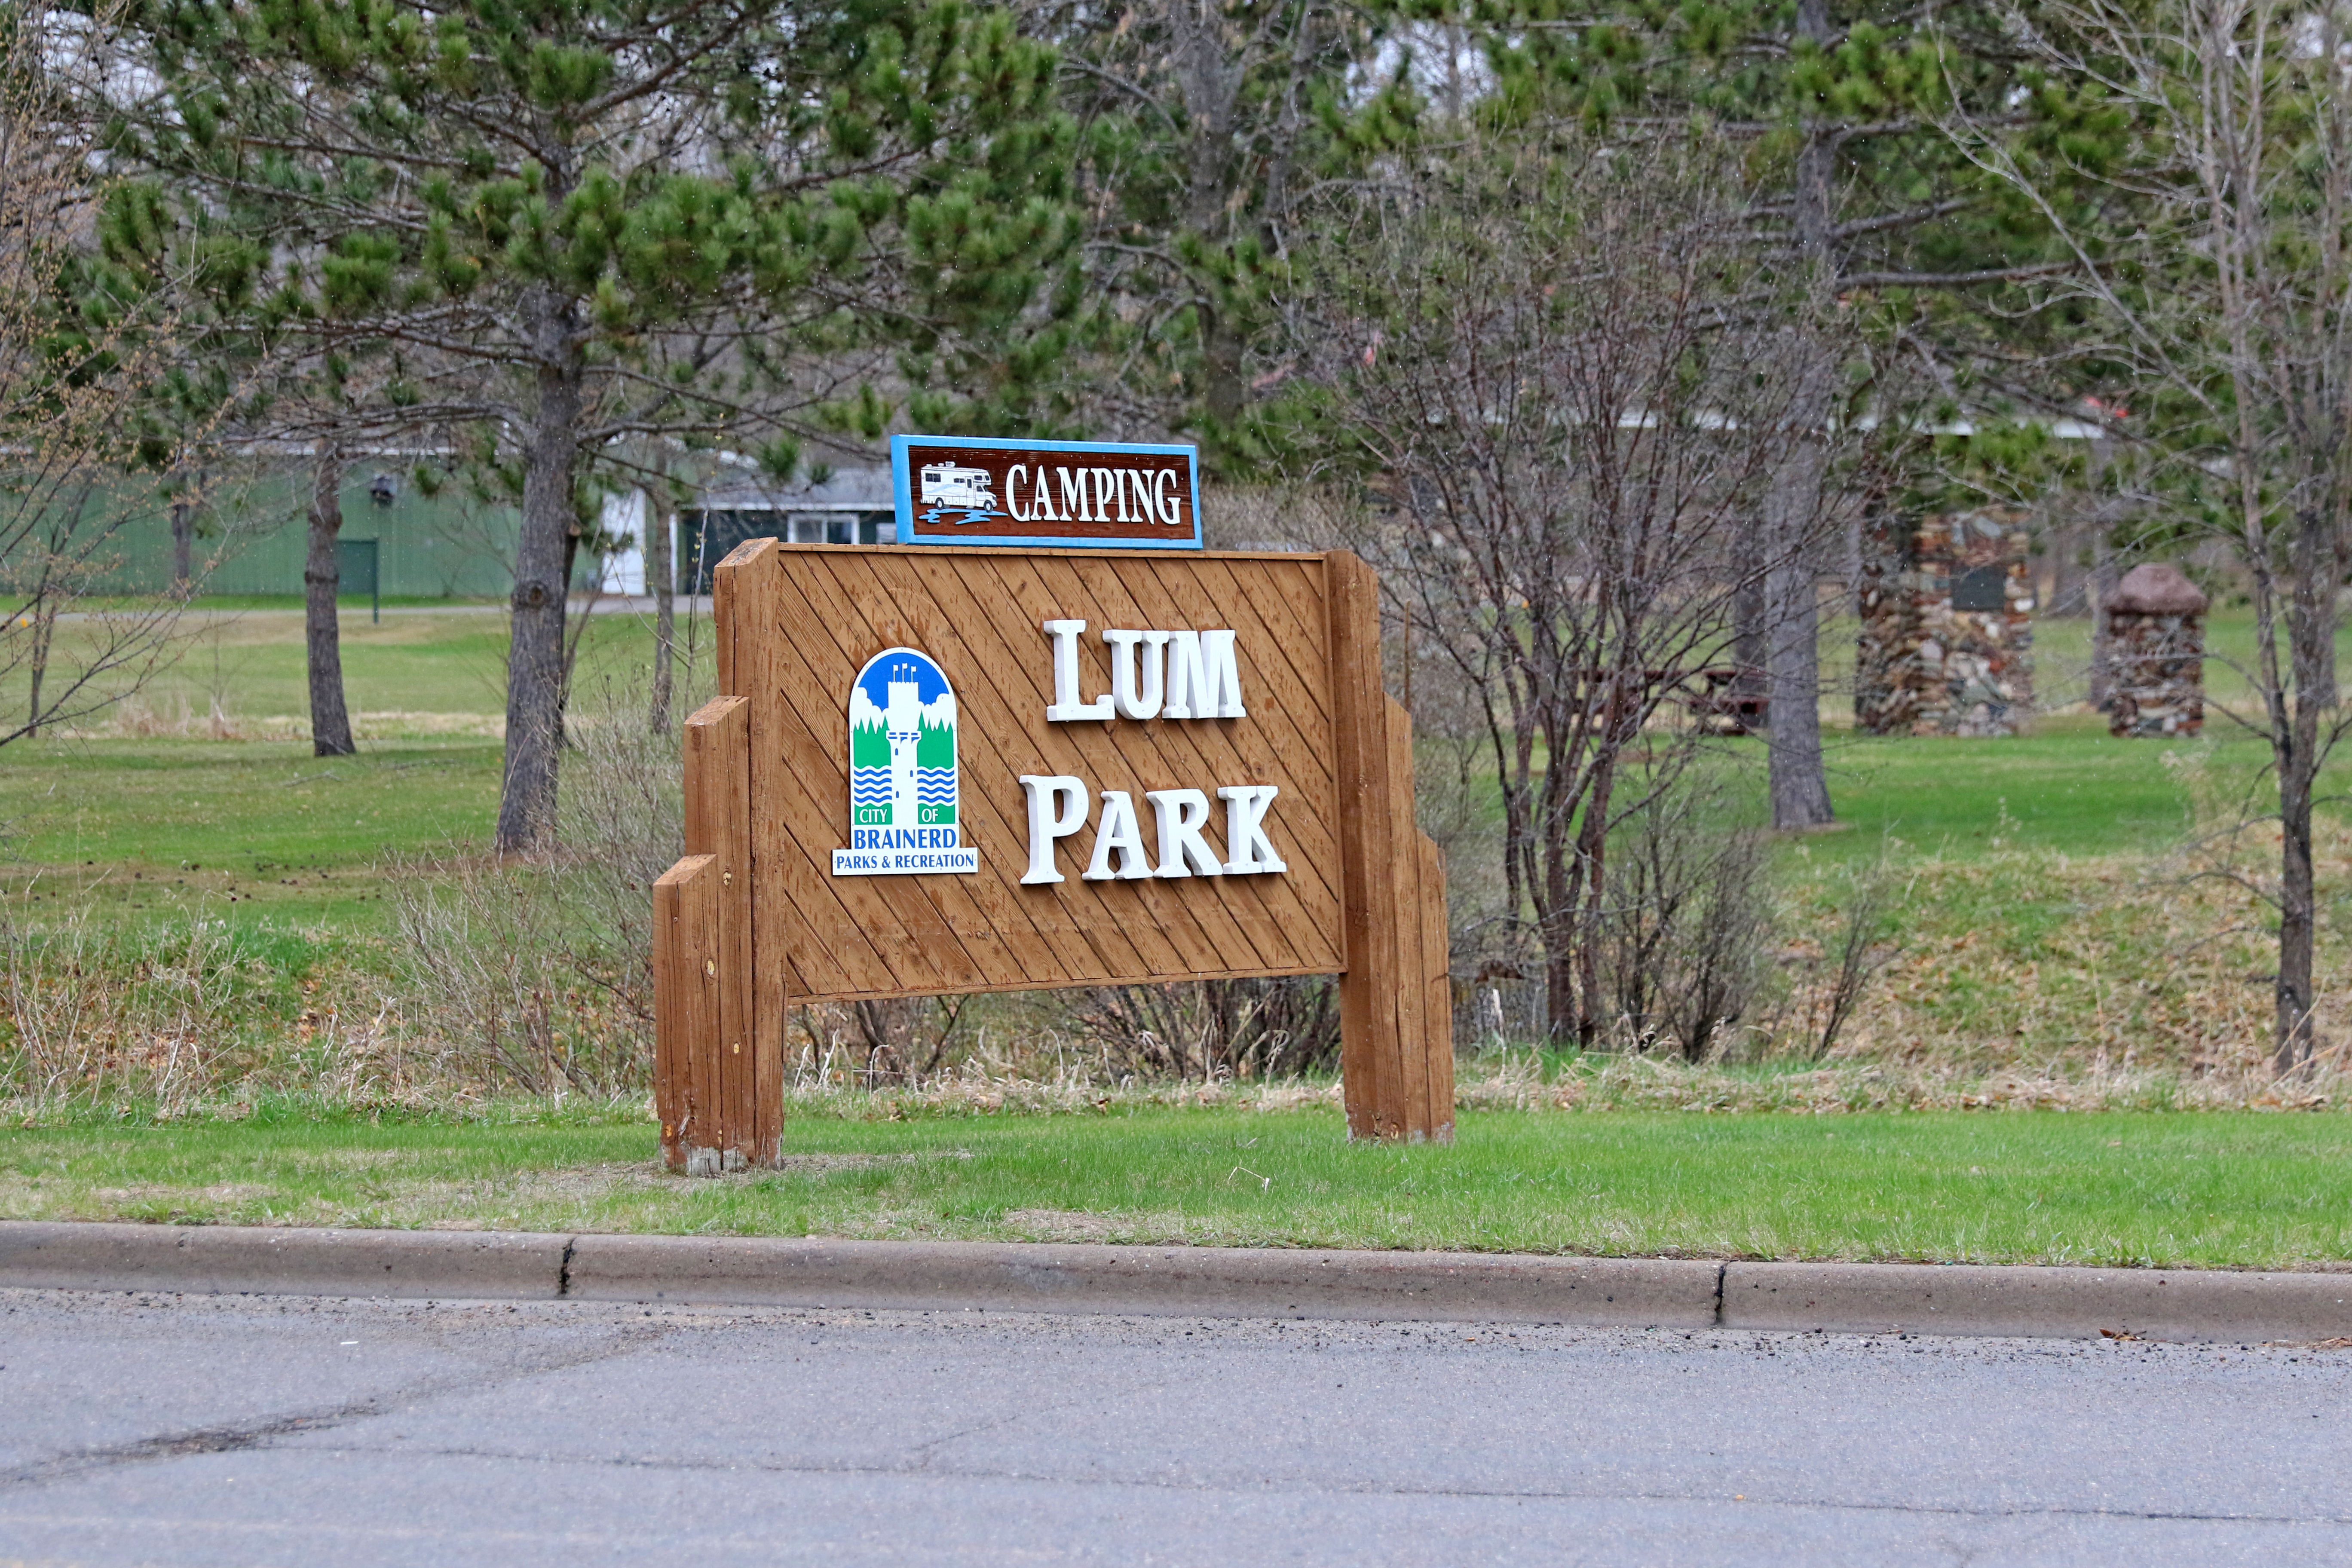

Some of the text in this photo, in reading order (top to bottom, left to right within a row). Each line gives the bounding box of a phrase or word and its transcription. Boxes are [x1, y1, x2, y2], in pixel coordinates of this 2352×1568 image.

[1005, 464, 1181, 525] CAMPING
[1043, 619, 1246, 722] LUM
[859, 808, 938, 823] CITY OF
[1019, 775, 1288, 884] PARK
[854, 828, 956, 849] BRAINERD
[836, 854, 974, 869] PARKS & RECREATION
